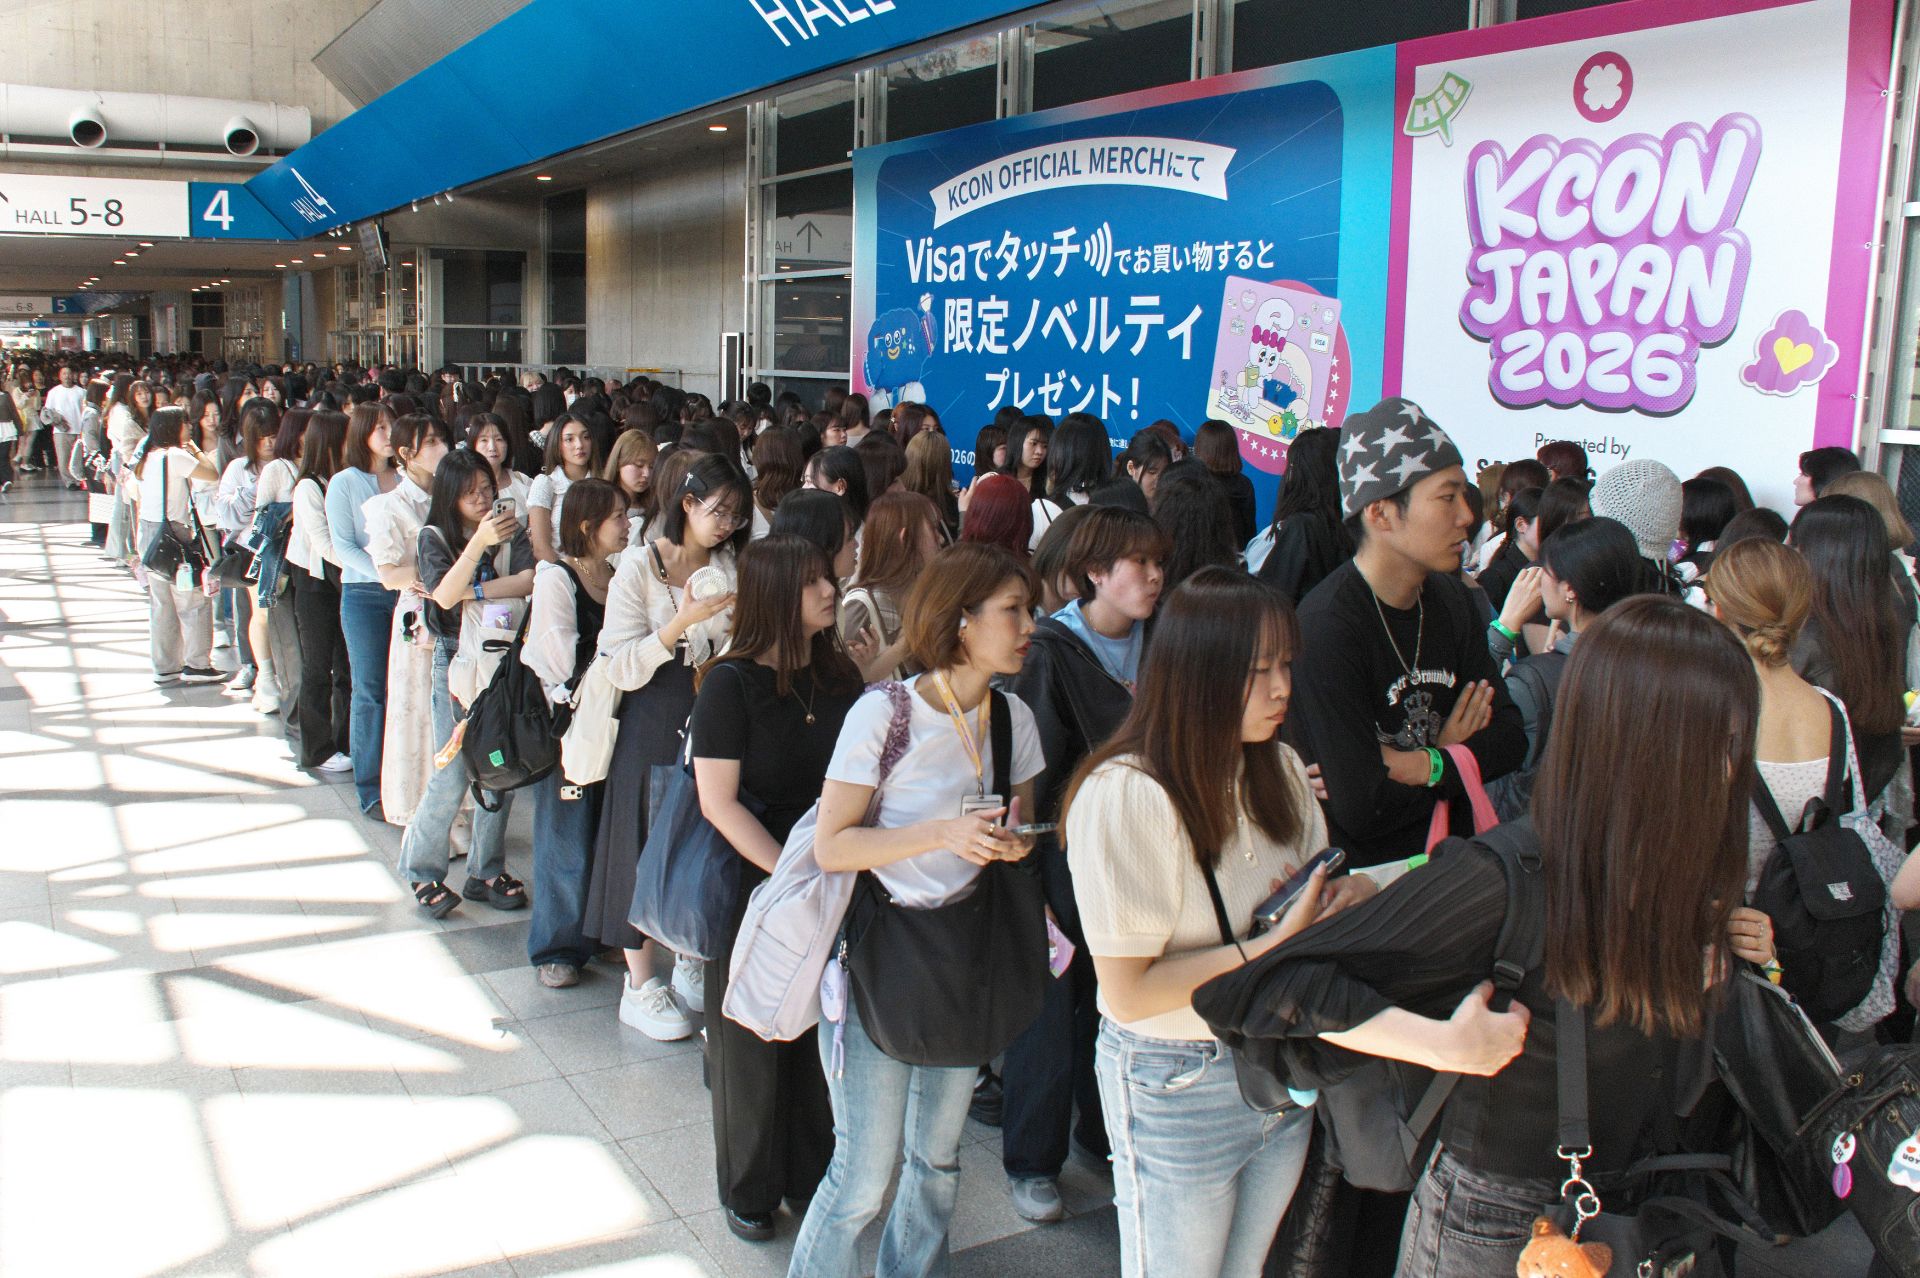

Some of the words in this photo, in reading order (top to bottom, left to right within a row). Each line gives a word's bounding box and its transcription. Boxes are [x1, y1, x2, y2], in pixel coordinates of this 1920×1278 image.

[750, 0, 897, 47] HA
[291, 168, 336, 214] 4
[948, 170, 993, 211] KCON
[999, 150, 1082, 190] OFFICIAL
[1089, 147, 1205, 182] MERCHにて
[1475, 128, 1749, 248] KCON
[16, 209, 62, 225] HALL
[70, 198, 124, 227] 5-8
[203, 190, 235, 231] 4
[291, 196, 327, 223] HALL
[905, 225, 1081, 285] Visaでタッチ
[1113, 239, 1275, 274] でお買い物すると
[16, 302, 33, 312] 6-8
[57, 299, 67, 313] 5
[1469, 242, 1736, 327] JAPAN
[944, 294, 1202, 360] 限定ノベルティ
[1499, 329, 1685, 397] 2026
[1535, 432, 1607, 454] Prted
[1610, 437, 1631, 460] by
